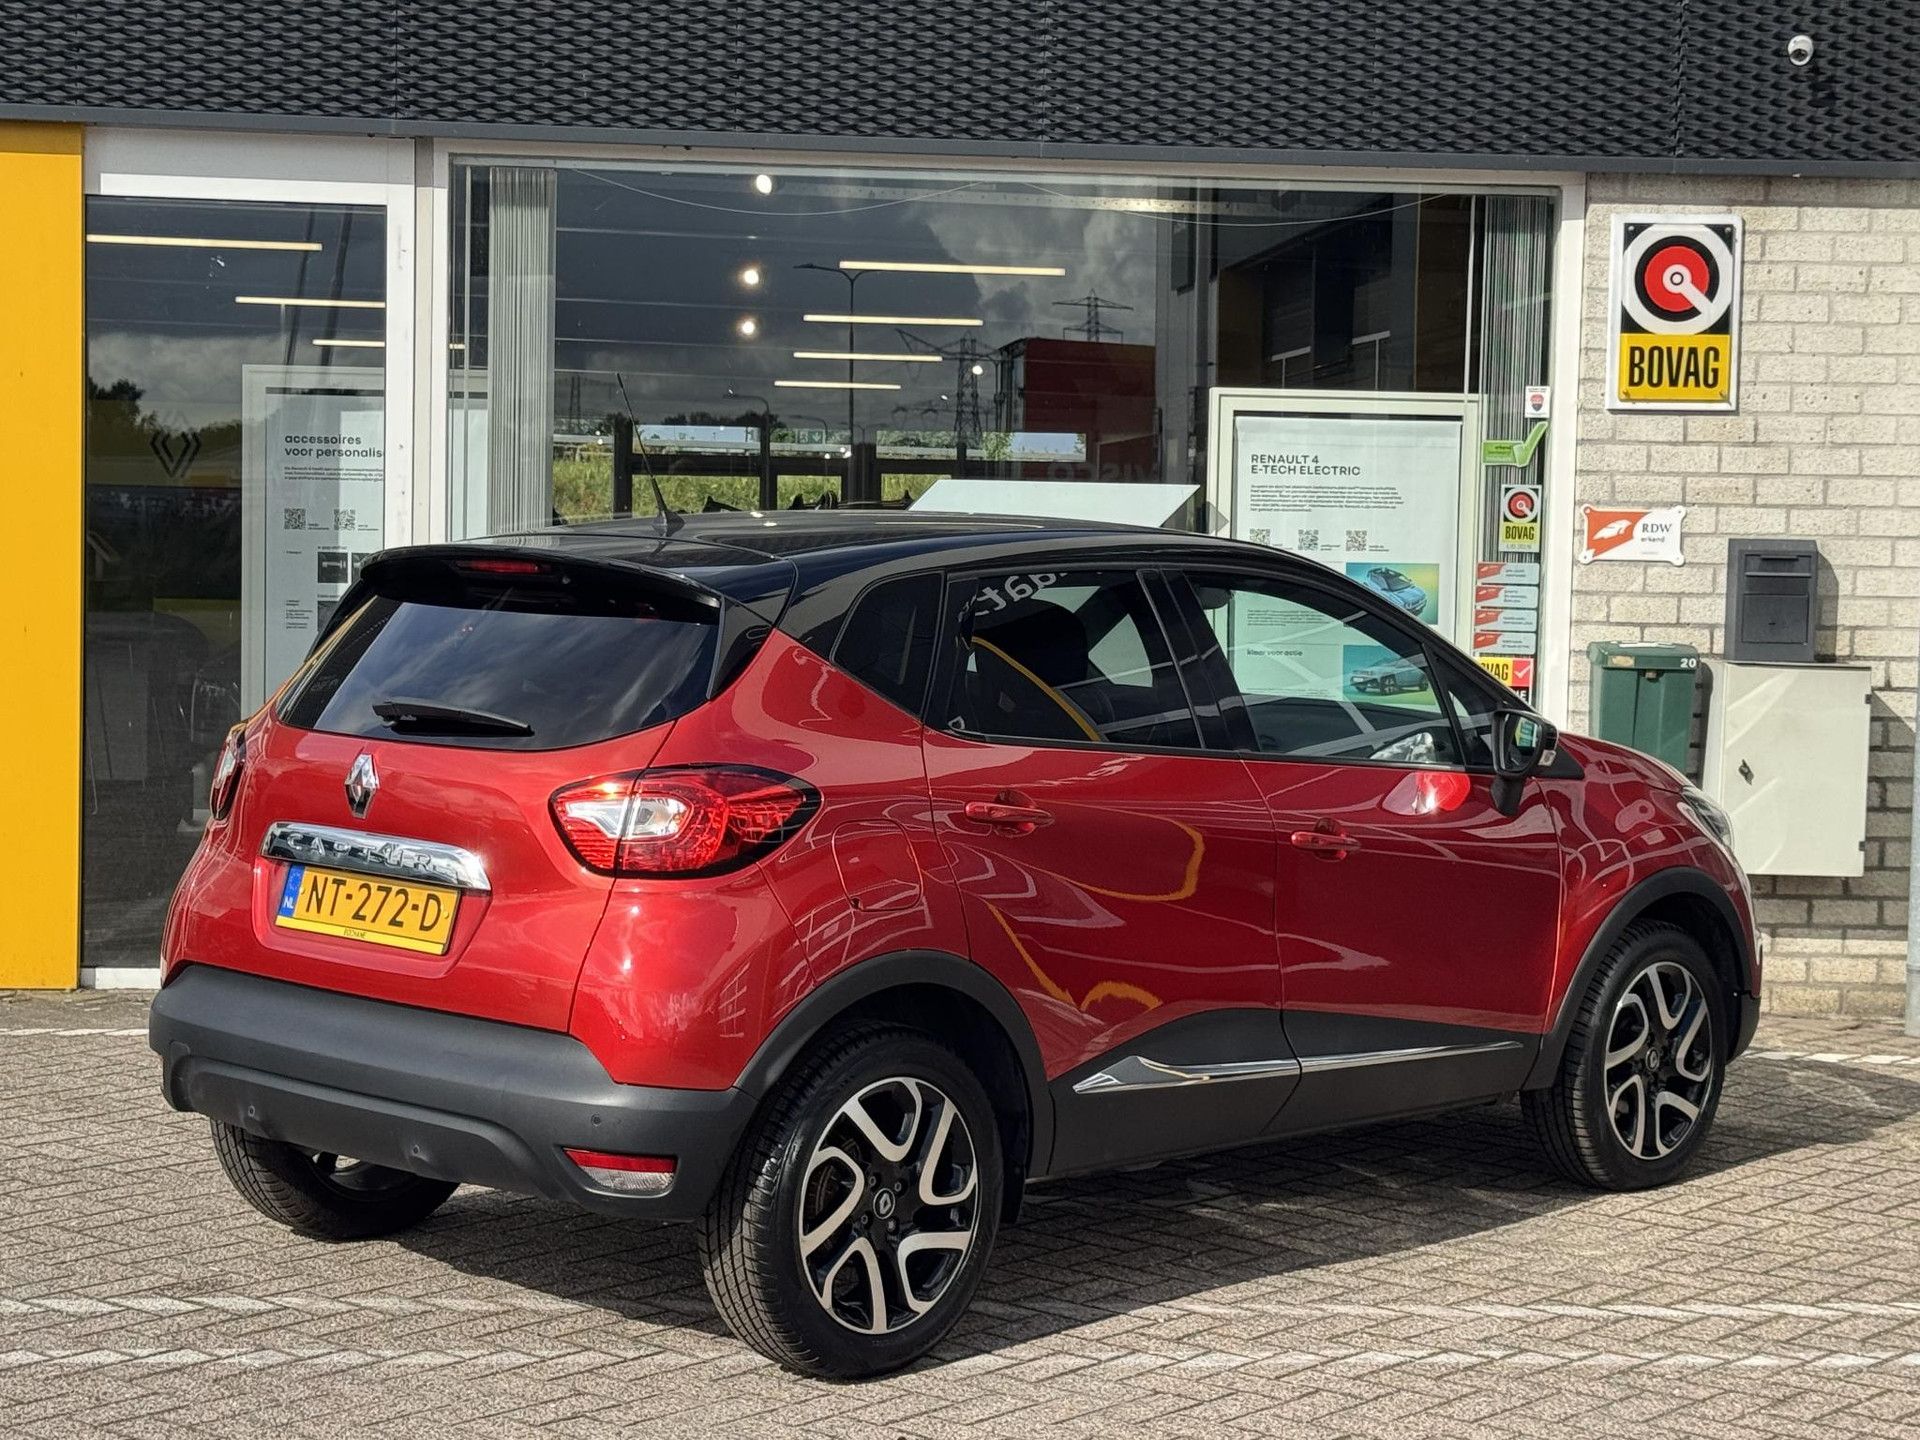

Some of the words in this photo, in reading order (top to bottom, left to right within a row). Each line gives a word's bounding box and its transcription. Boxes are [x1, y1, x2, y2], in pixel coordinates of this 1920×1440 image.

[1628, 345, 1720, 388] BOVAG
[284, 434, 362, 445] accessoires
[284, 447, 313, 456] voor
[316, 446, 384, 459] personalis
[1251, 454, 1310, 464] RENAULT
[1312, 455, 1319, 464] 4
[1251, 465, 1297, 474] E-TECH
[1300, 466, 1361, 476] ELECTRIC
[1505, 525, 1535, 541] BOVAG
[1641, 523, 1673, 533] RDW
[1680, 658, 1697, 668] 20
[287, 833, 432, 870] CAPTUR
[283, 895, 294, 909] NL
[305, 875, 442, 931] NT-272-D
